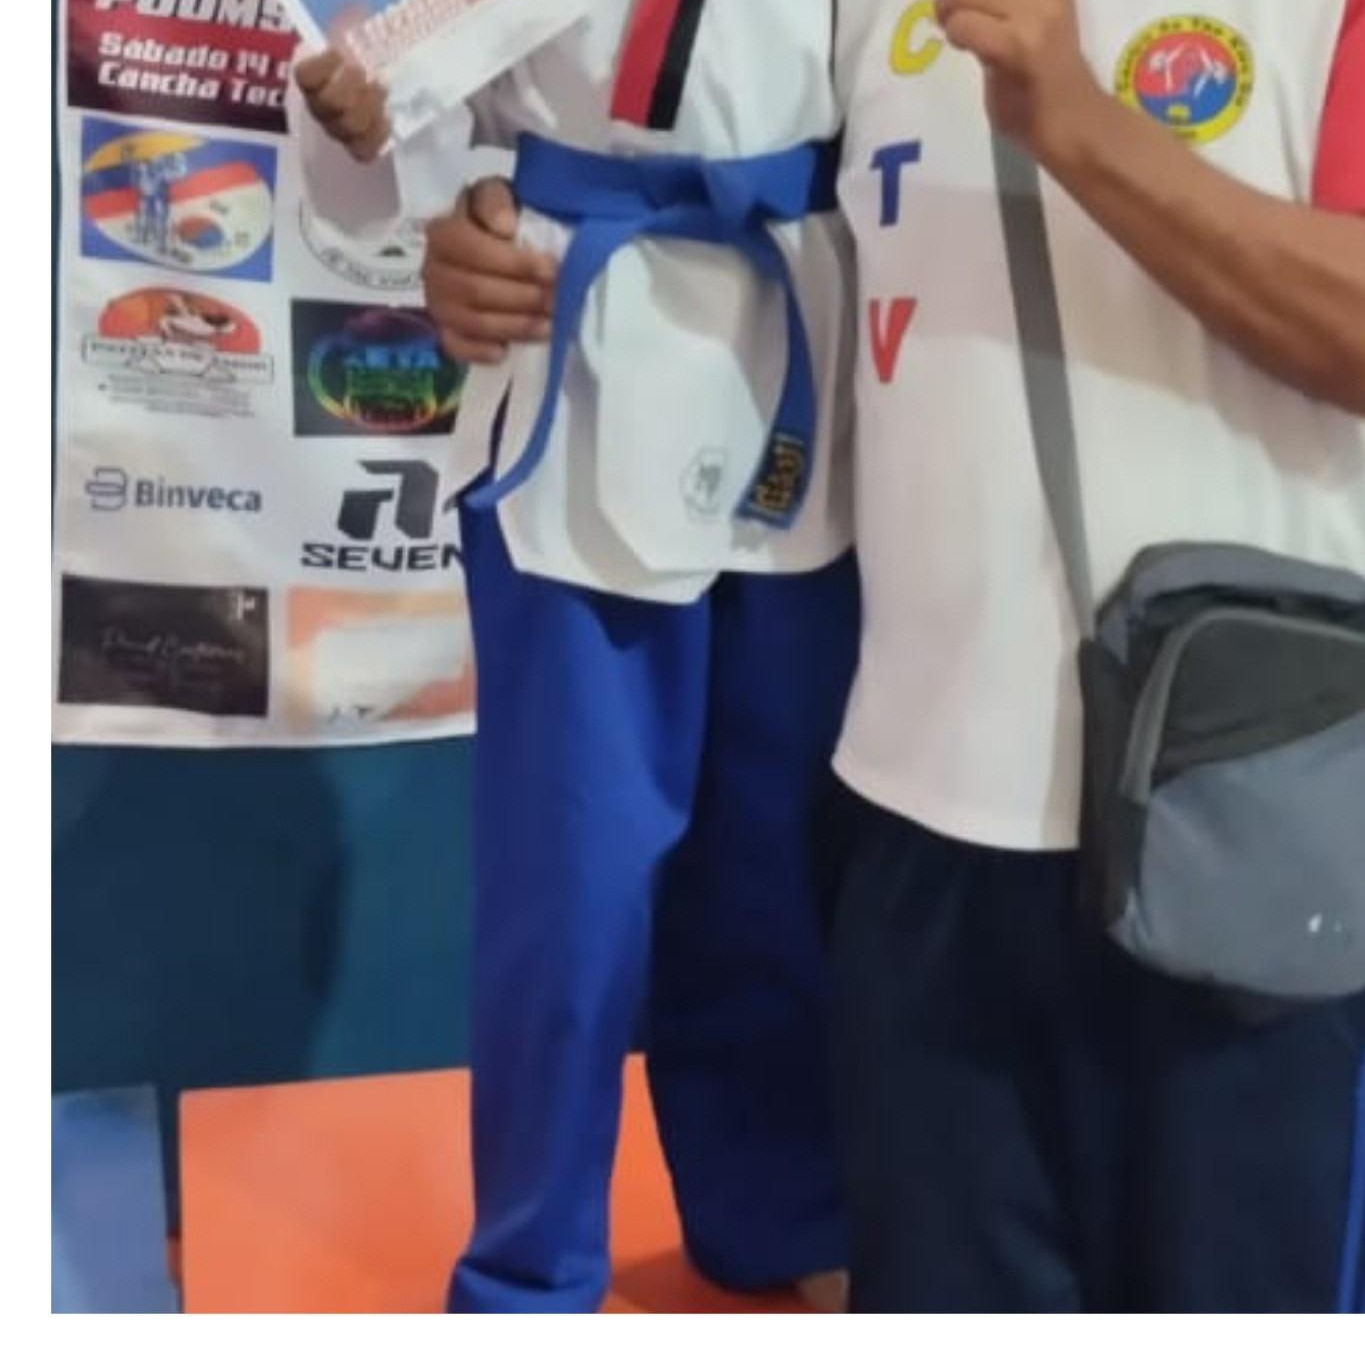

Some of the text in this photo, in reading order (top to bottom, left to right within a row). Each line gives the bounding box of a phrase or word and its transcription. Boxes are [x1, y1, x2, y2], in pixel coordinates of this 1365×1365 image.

[98, 60, 221, 101] Cancha
[869, 138, 922, 228] T
[868, 297, 918, 384] V
[135, 478, 263, 513] Binveca
